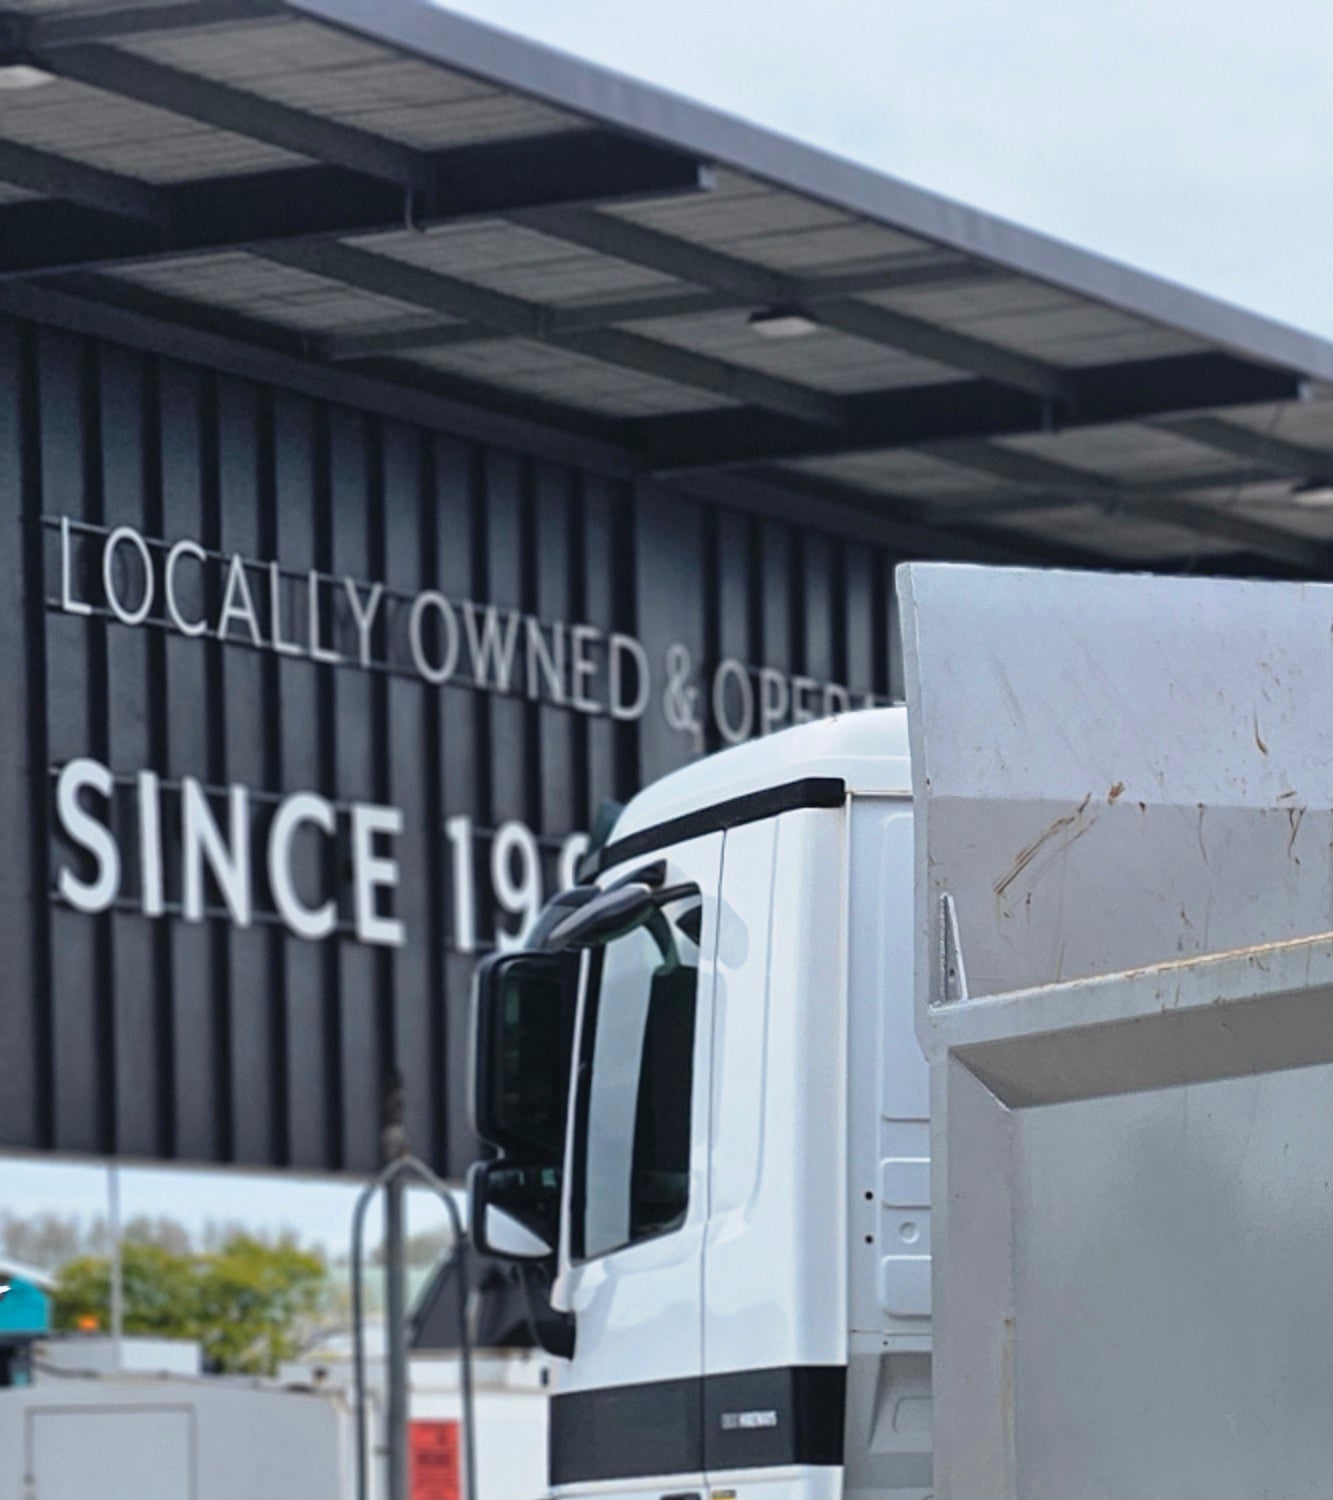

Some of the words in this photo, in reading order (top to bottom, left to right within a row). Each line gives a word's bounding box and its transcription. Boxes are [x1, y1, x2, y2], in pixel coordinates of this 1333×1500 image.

[60, 515, 384, 667] LOCALLY
[409, 590, 652, 722] OWNED
[662, 642, 704, 733] &
[57, 757, 406, 947] SINCE
